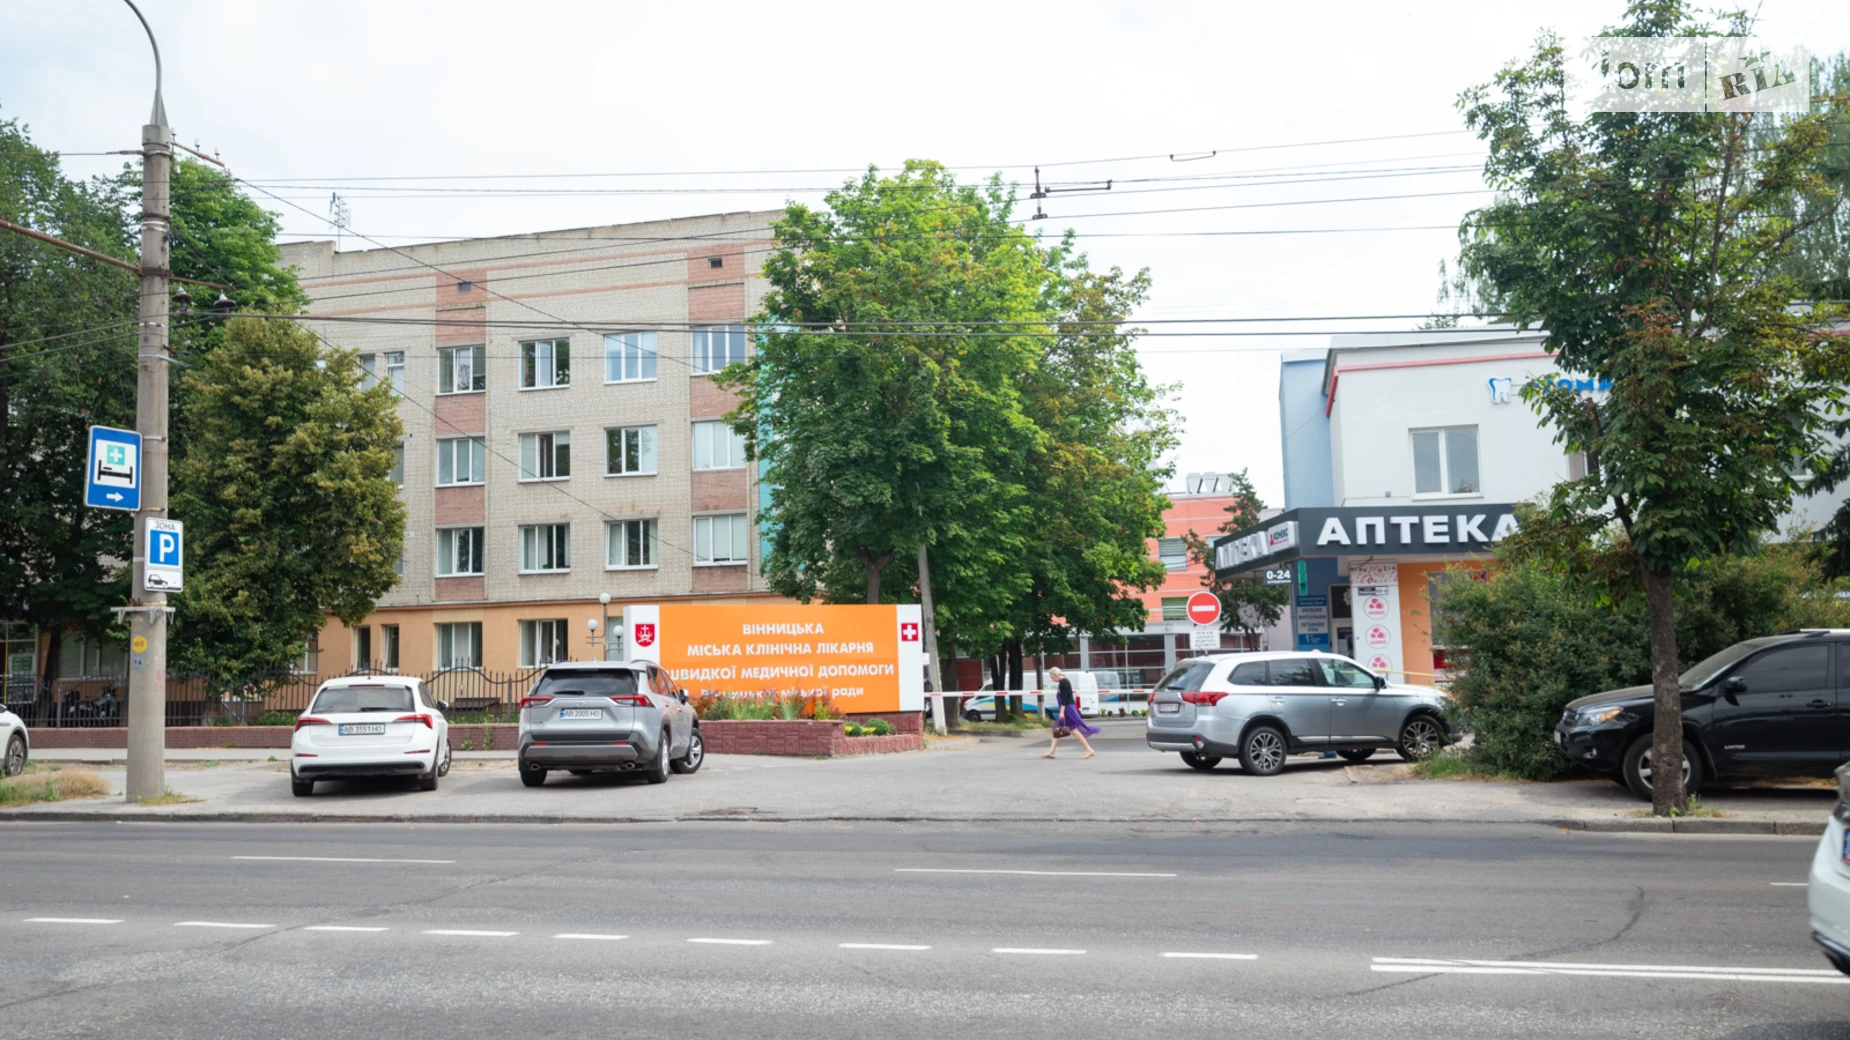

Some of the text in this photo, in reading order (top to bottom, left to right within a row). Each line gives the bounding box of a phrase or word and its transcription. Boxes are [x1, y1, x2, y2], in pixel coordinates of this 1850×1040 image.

[154, 521, 176, 531] ЗОНА
[1316, 513, 1520, 546] АПТЕКА
[1266, 570, 1291, 581] 0-24
[742, 623, 825, 636] ВІННИЦЬКА
[687, 642, 875, 656] МІСЬКА КЛІНІЧНА ЛІКАРНЯ
[667, 664, 894, 682] ШВИДКОЇ МЕДИЧНОЇ ДОПОМОГИ
[781, 685, 829, 698] міької
[832, 687, 864, 699] ради
